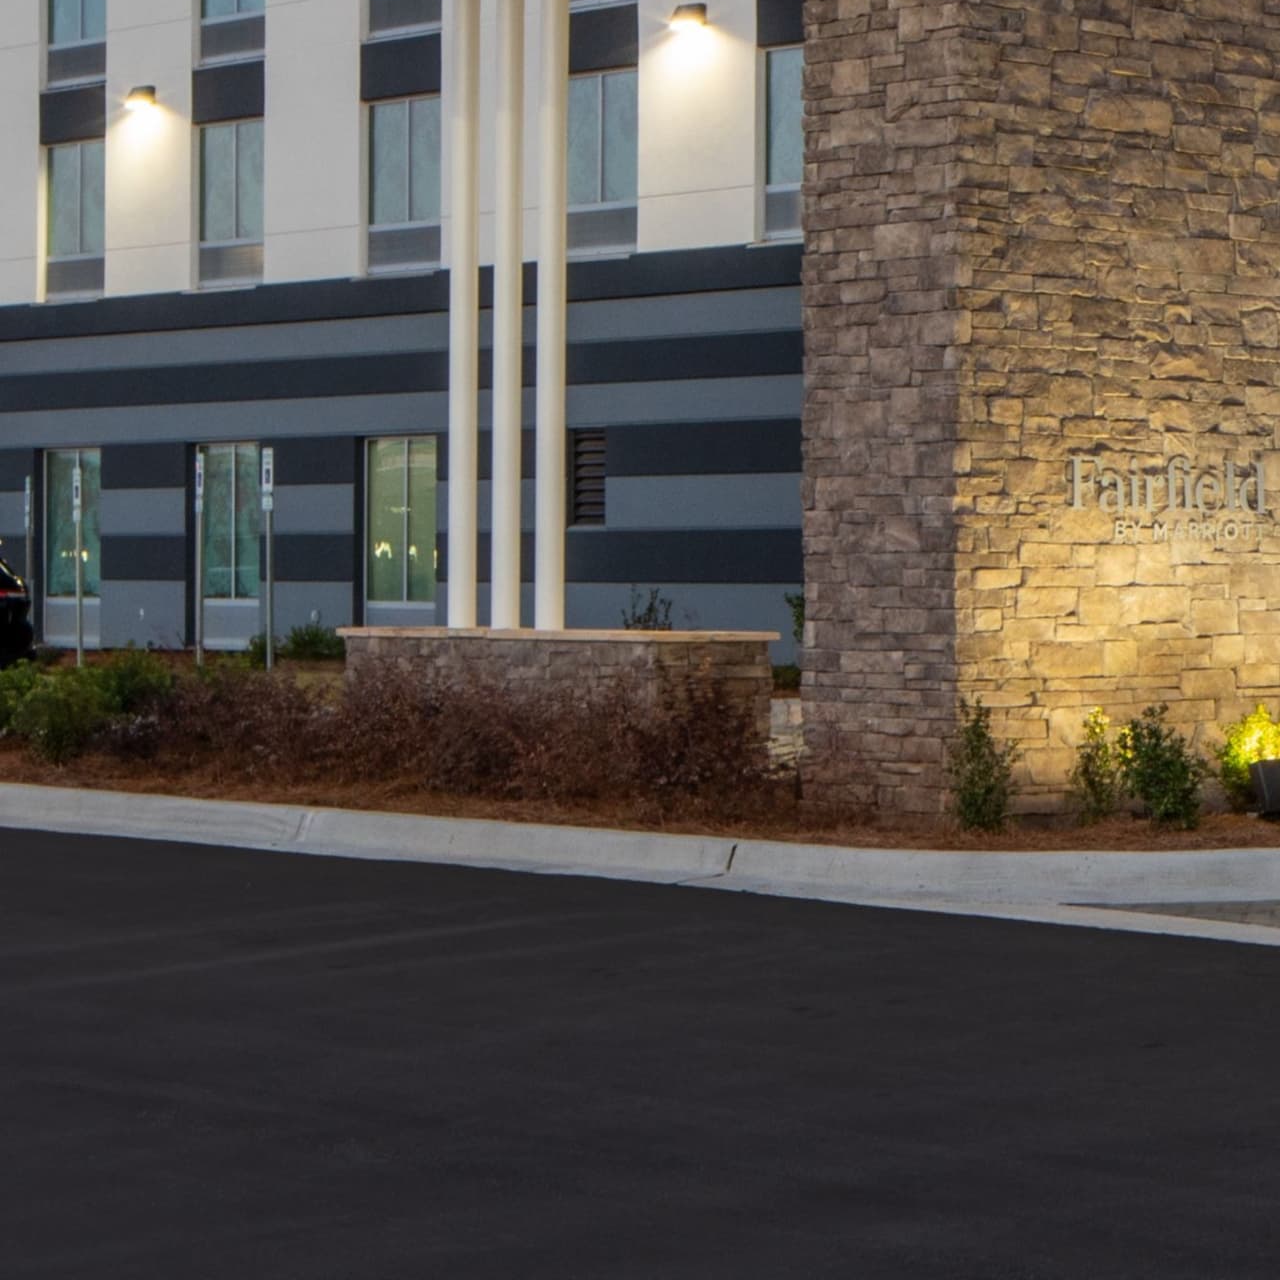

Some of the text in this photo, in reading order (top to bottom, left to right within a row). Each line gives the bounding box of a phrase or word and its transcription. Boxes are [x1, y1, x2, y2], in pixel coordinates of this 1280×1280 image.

[1070, 454, 1267, 515] Fairfield
[1115, 520, 1265, 542] BY MARRIOTT
